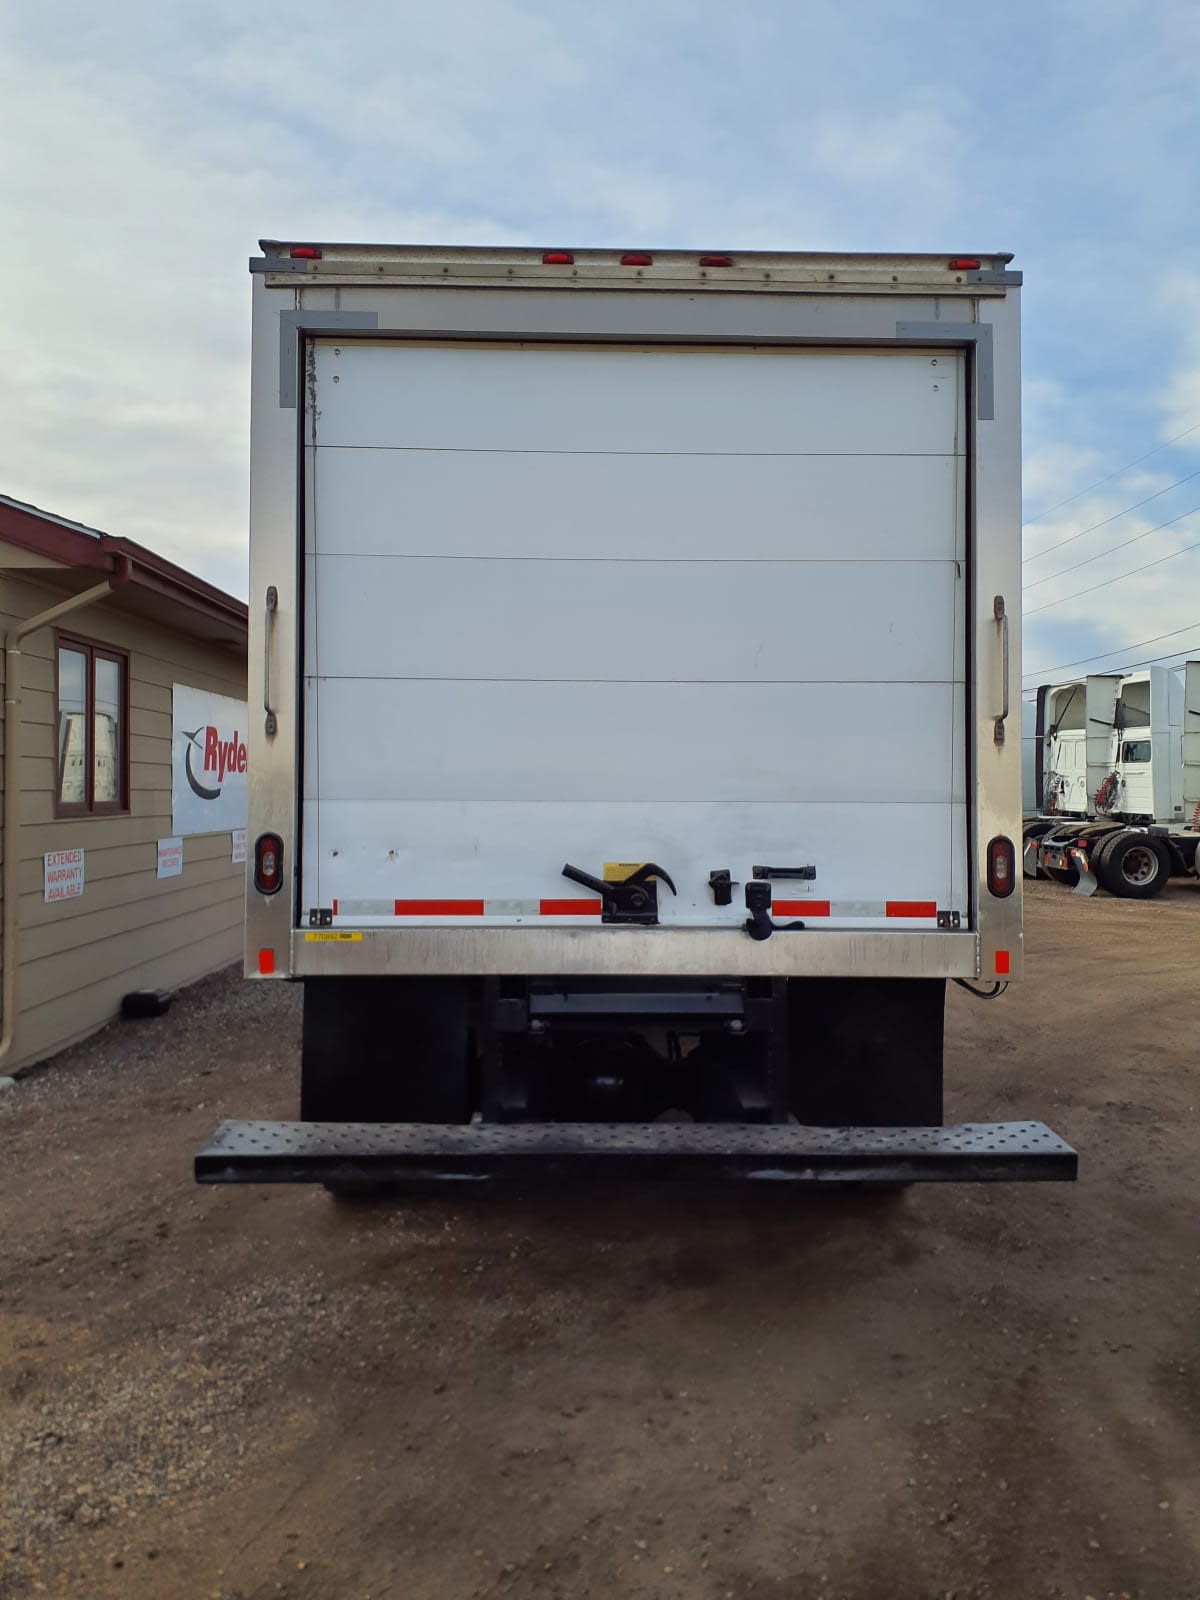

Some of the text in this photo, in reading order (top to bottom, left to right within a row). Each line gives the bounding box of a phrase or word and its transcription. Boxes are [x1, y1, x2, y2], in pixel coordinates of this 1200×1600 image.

[204, 725, 248, 783] Ryde
[47, 850, 81, 867] EXTENDED
[47, 867, 82, 884] WARRANTY
[48, 882, 81, 900] AVAILABLE
